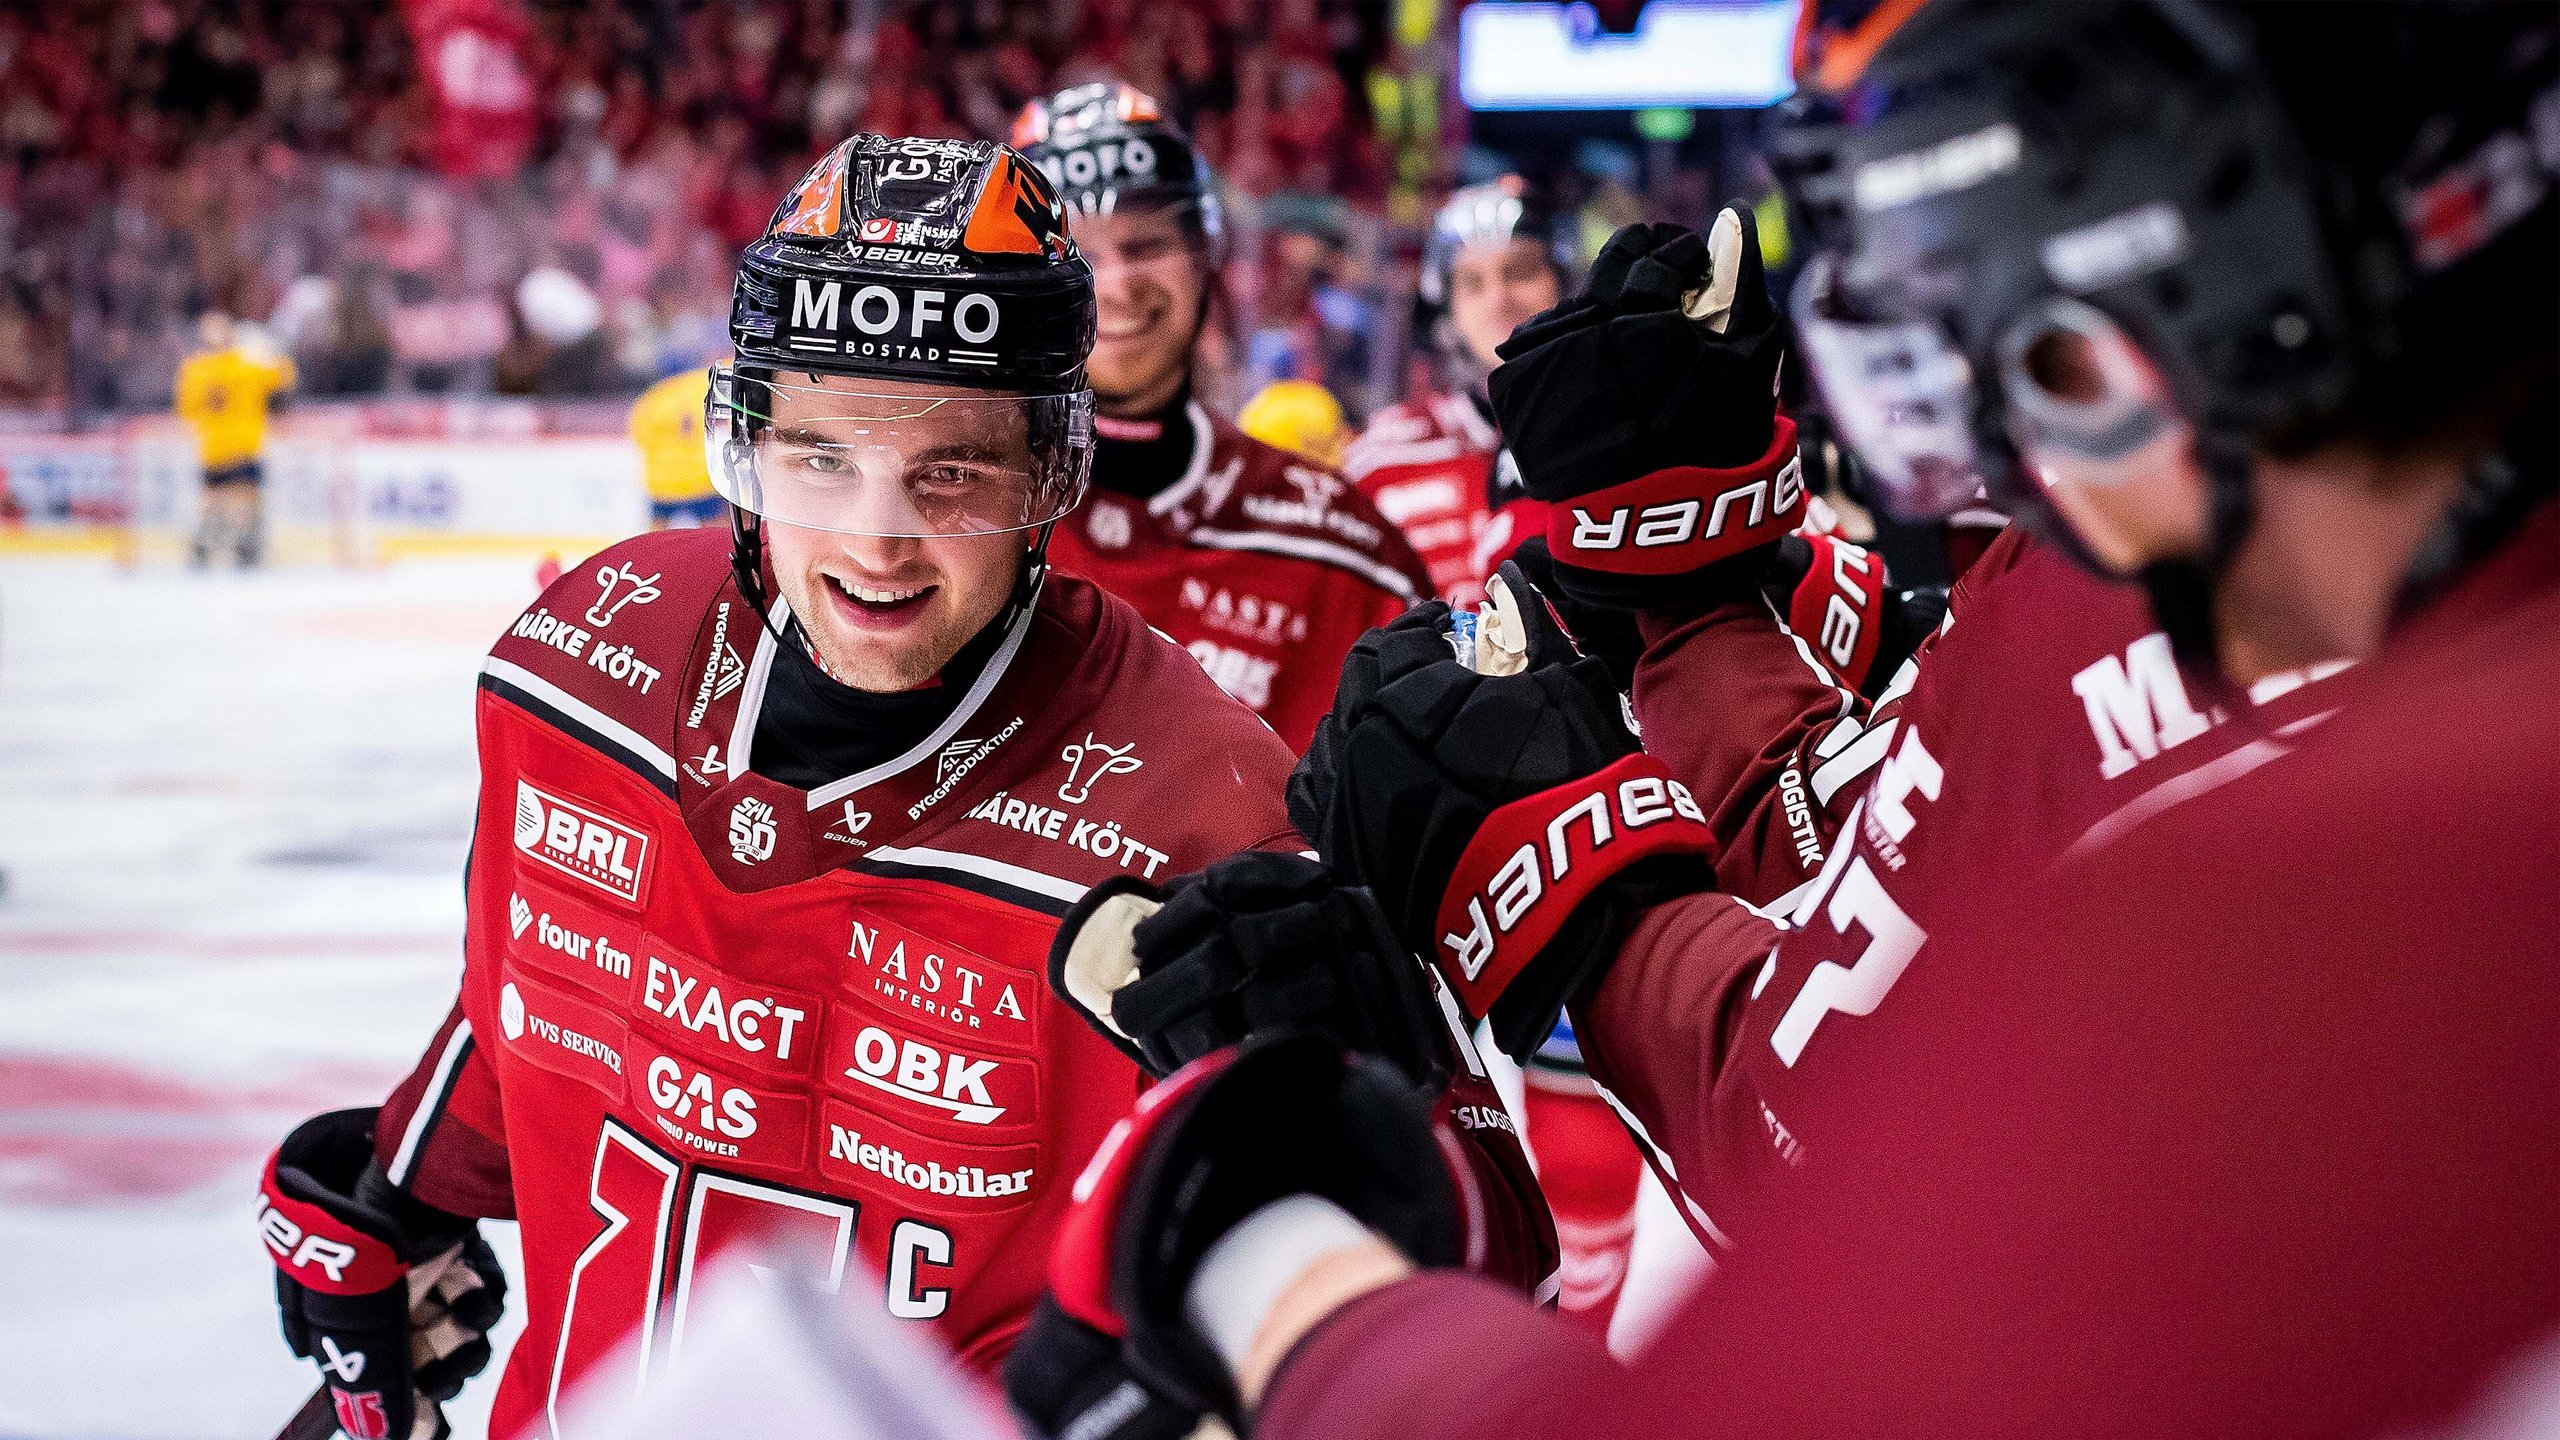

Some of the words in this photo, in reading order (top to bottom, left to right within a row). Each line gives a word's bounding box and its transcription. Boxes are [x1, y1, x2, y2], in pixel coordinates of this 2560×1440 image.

[863, 246, 960, 267] BAUER
[894, 233, 926, 247] SPEL
[895, 222, 963, 240] SVENSKA
[790, 279, 1000, 344] MOFO
[845, 340, 941, 362] BOSTAD
[1571, 445, 1805, 549] AUER
[512, 607, 592, 659] NÄRKE
[588, 640, 662, 695] KÖTT
[686, 602, 731, 729] BYGGPRODUKTION
[719, 656, 736, 674] SL
[682, 762, 712, 788] BAUER
[907, 716, 1025, 821] BYGGPRODUKTION
[943, 757, 961, 773] SL
[545, 807, 635, 882] BRL
[728, 807, 778, 861] 50
[822, 831, 869, 848] BAUER
[1067, 818, 1171, 880] KÖTT
[537, 913, 592, 962] four
[595, 935, 632, 980] fm
[848, 920, 1027, 1022] NASTA
[874, 977, 982, 1030] INTERIÖR
[528, 1013, 561, 1045] VVS
[561, 1028, 623, 1076] SERVICE
[853, 1025, 1001, 1108] OBK
[647, 1055, 759, 1139] GAS
[684, 1131, 739, 1158] POWER
[829, 1123, 1034, 1198] Nettobilar
[888, 1219, 956, 1321] C
